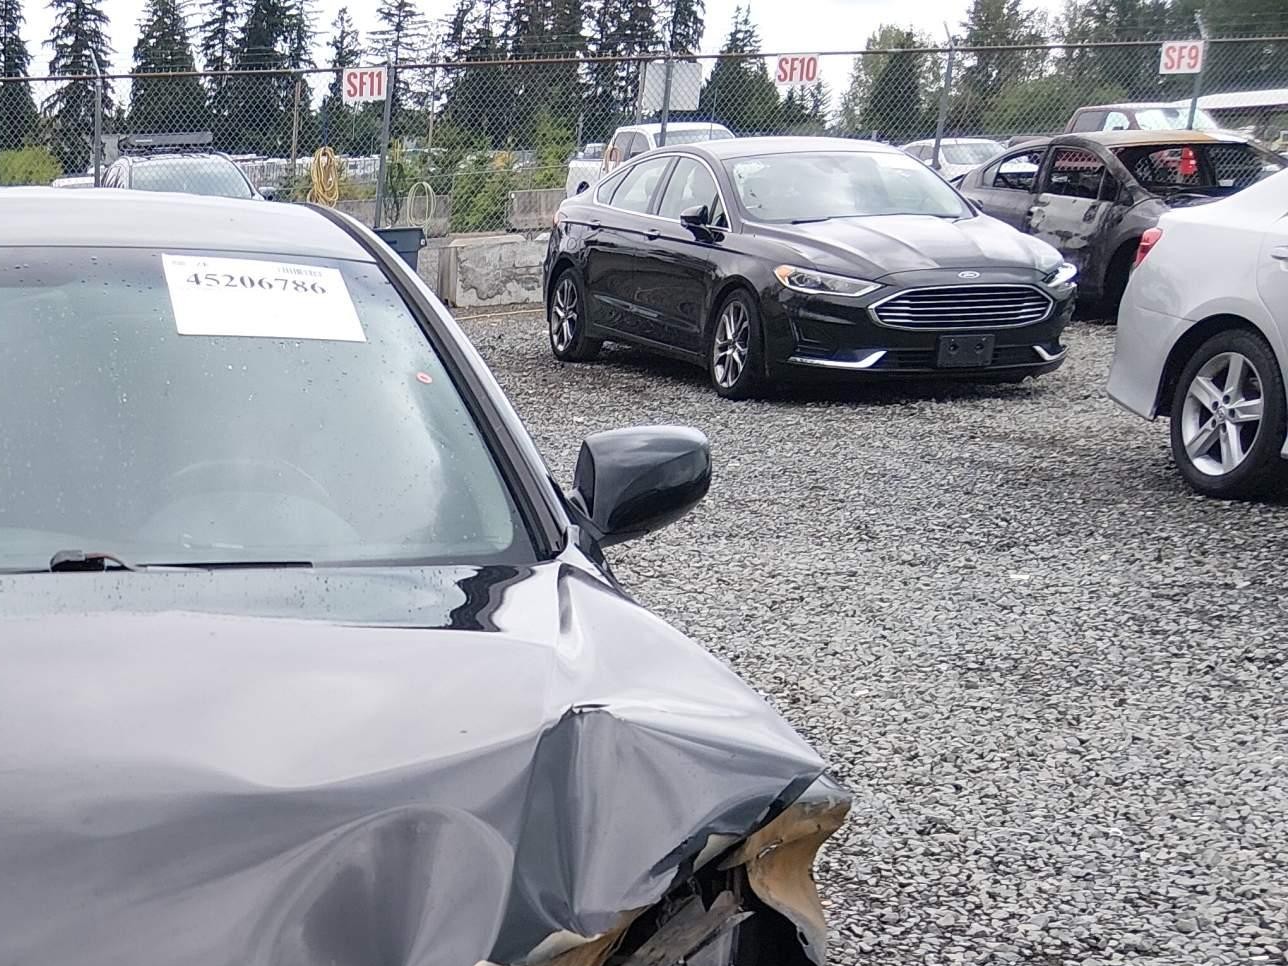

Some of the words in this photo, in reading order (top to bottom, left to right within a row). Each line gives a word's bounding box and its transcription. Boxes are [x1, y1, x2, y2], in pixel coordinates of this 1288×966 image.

[778, 56, 817, 82] SF10
[1164, 45, 1199, 70] SF9
[347, 71, 382, 98] SF11
[186, 273, 327, 294] 45206786
